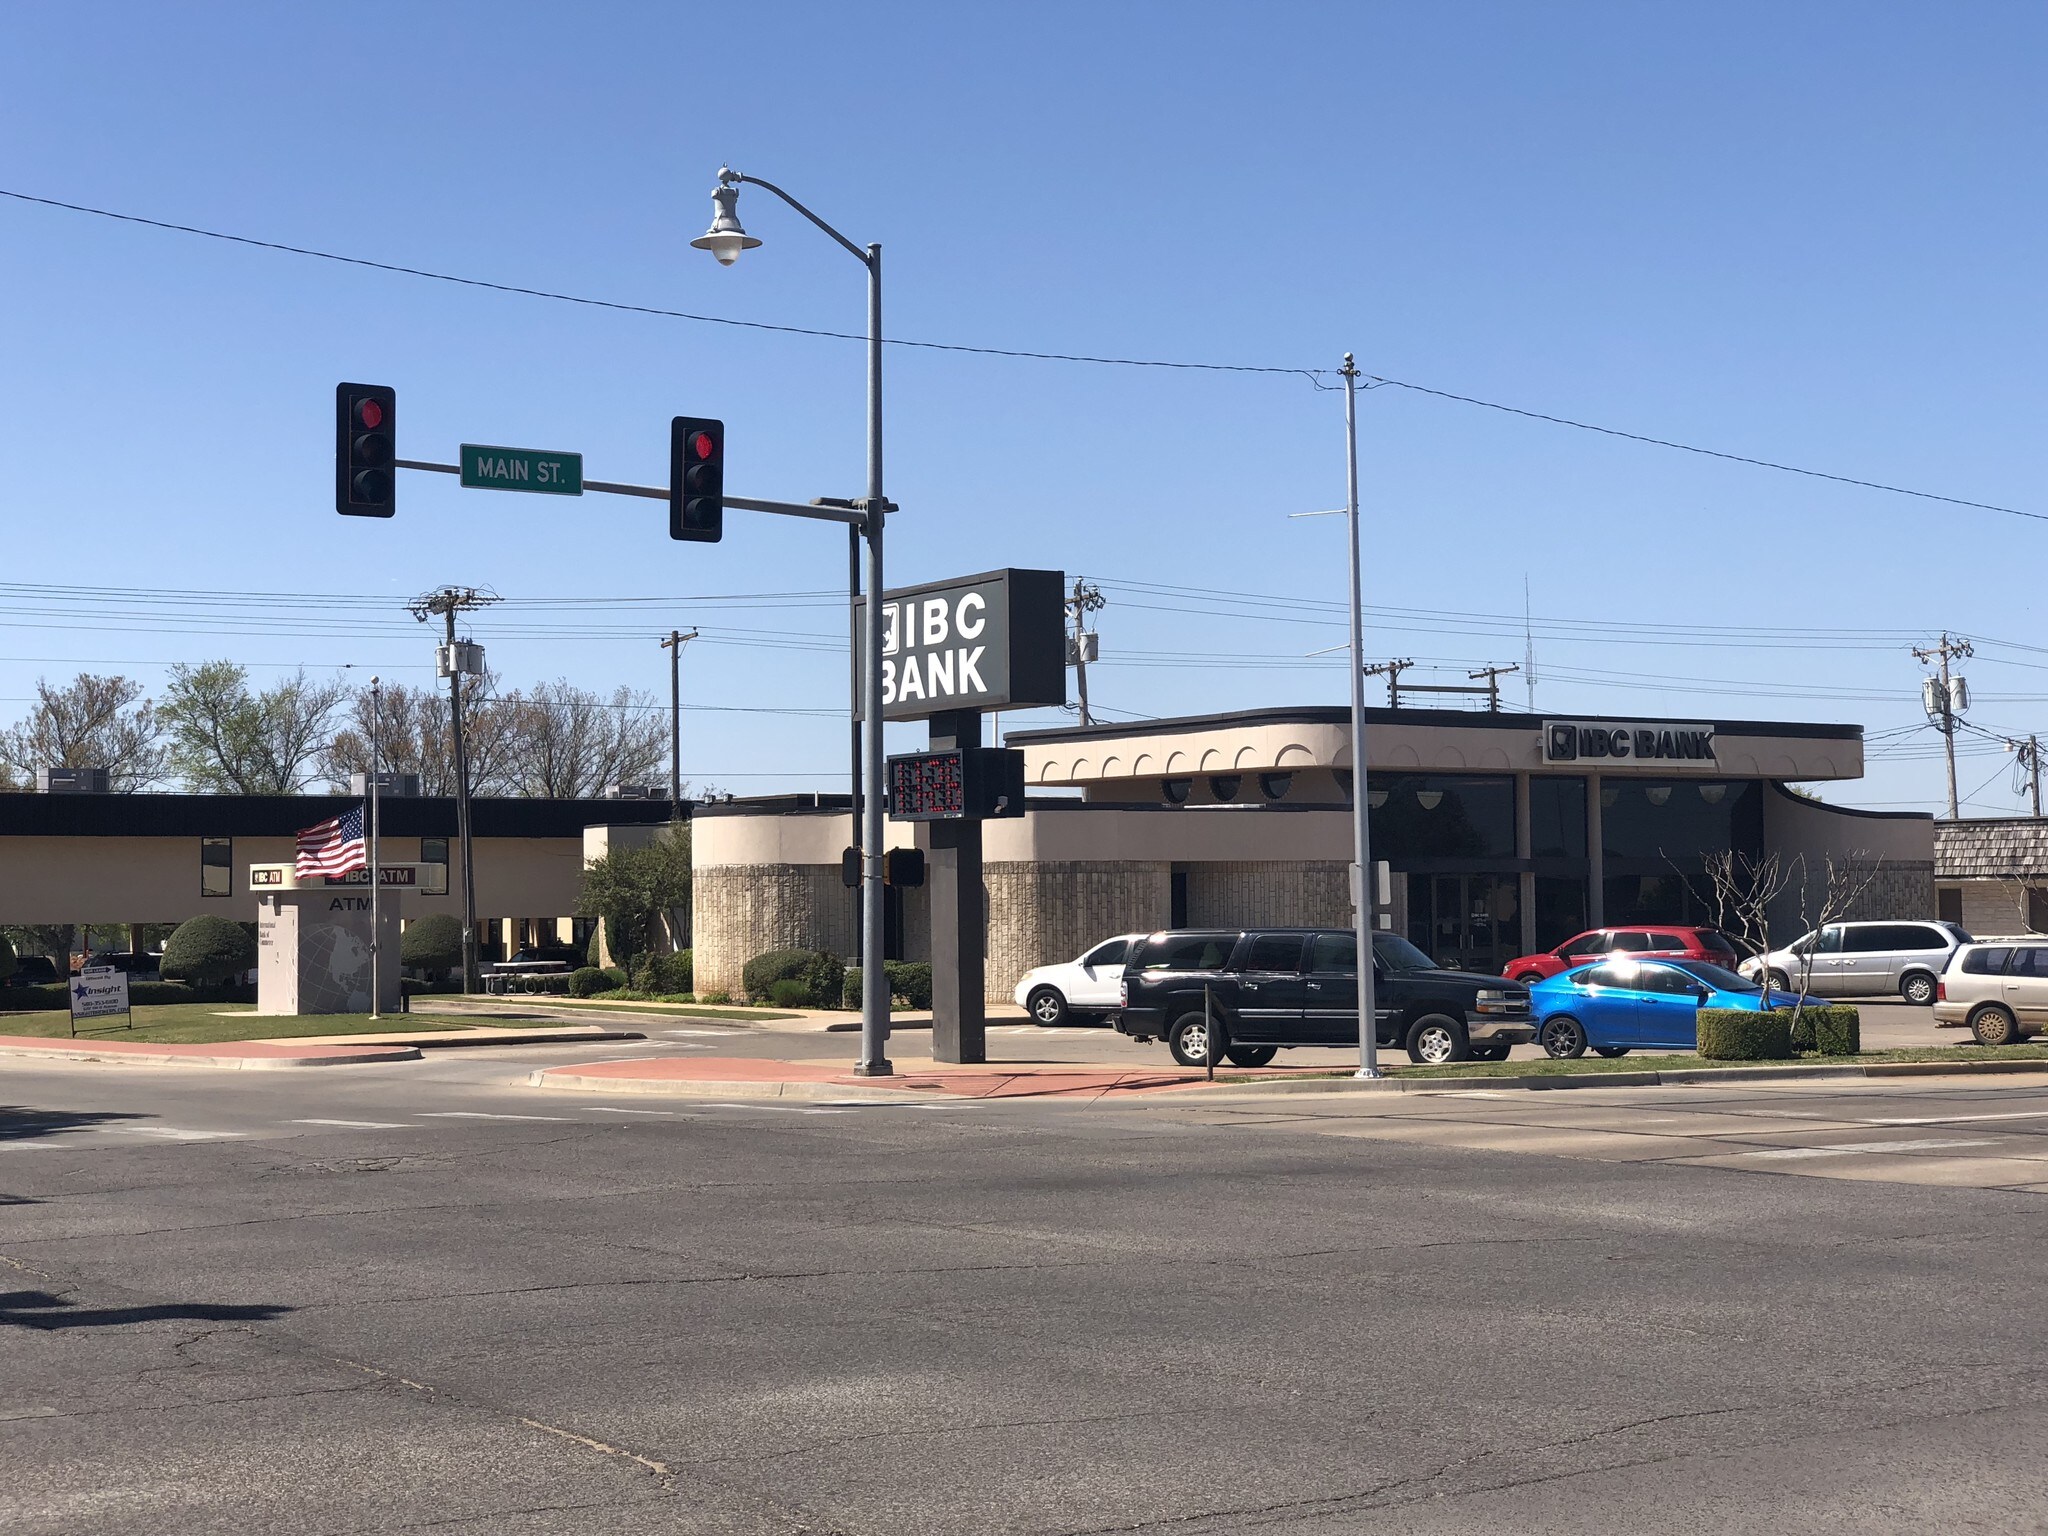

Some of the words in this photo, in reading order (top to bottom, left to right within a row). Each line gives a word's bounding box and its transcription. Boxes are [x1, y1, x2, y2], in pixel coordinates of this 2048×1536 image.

[477, 456, 529, 481] MAIN
[536, 461, 565, 484] ST.
[906, 592, 986, 649] IBC
[883, 645, 988, 706] BANK
[1579, 728, 1631, 758] IBC
[1634, 729, 1716, 760] BANK
[258, 871, 268, 883] IBC
[269, 871, 281, 883] ATM
[345, 870, 370, 883] IBC
[379, 870, 409, 883] ATM
[328, 897, 373, 911] ATM
[88, 985, 121, 995] Insight
